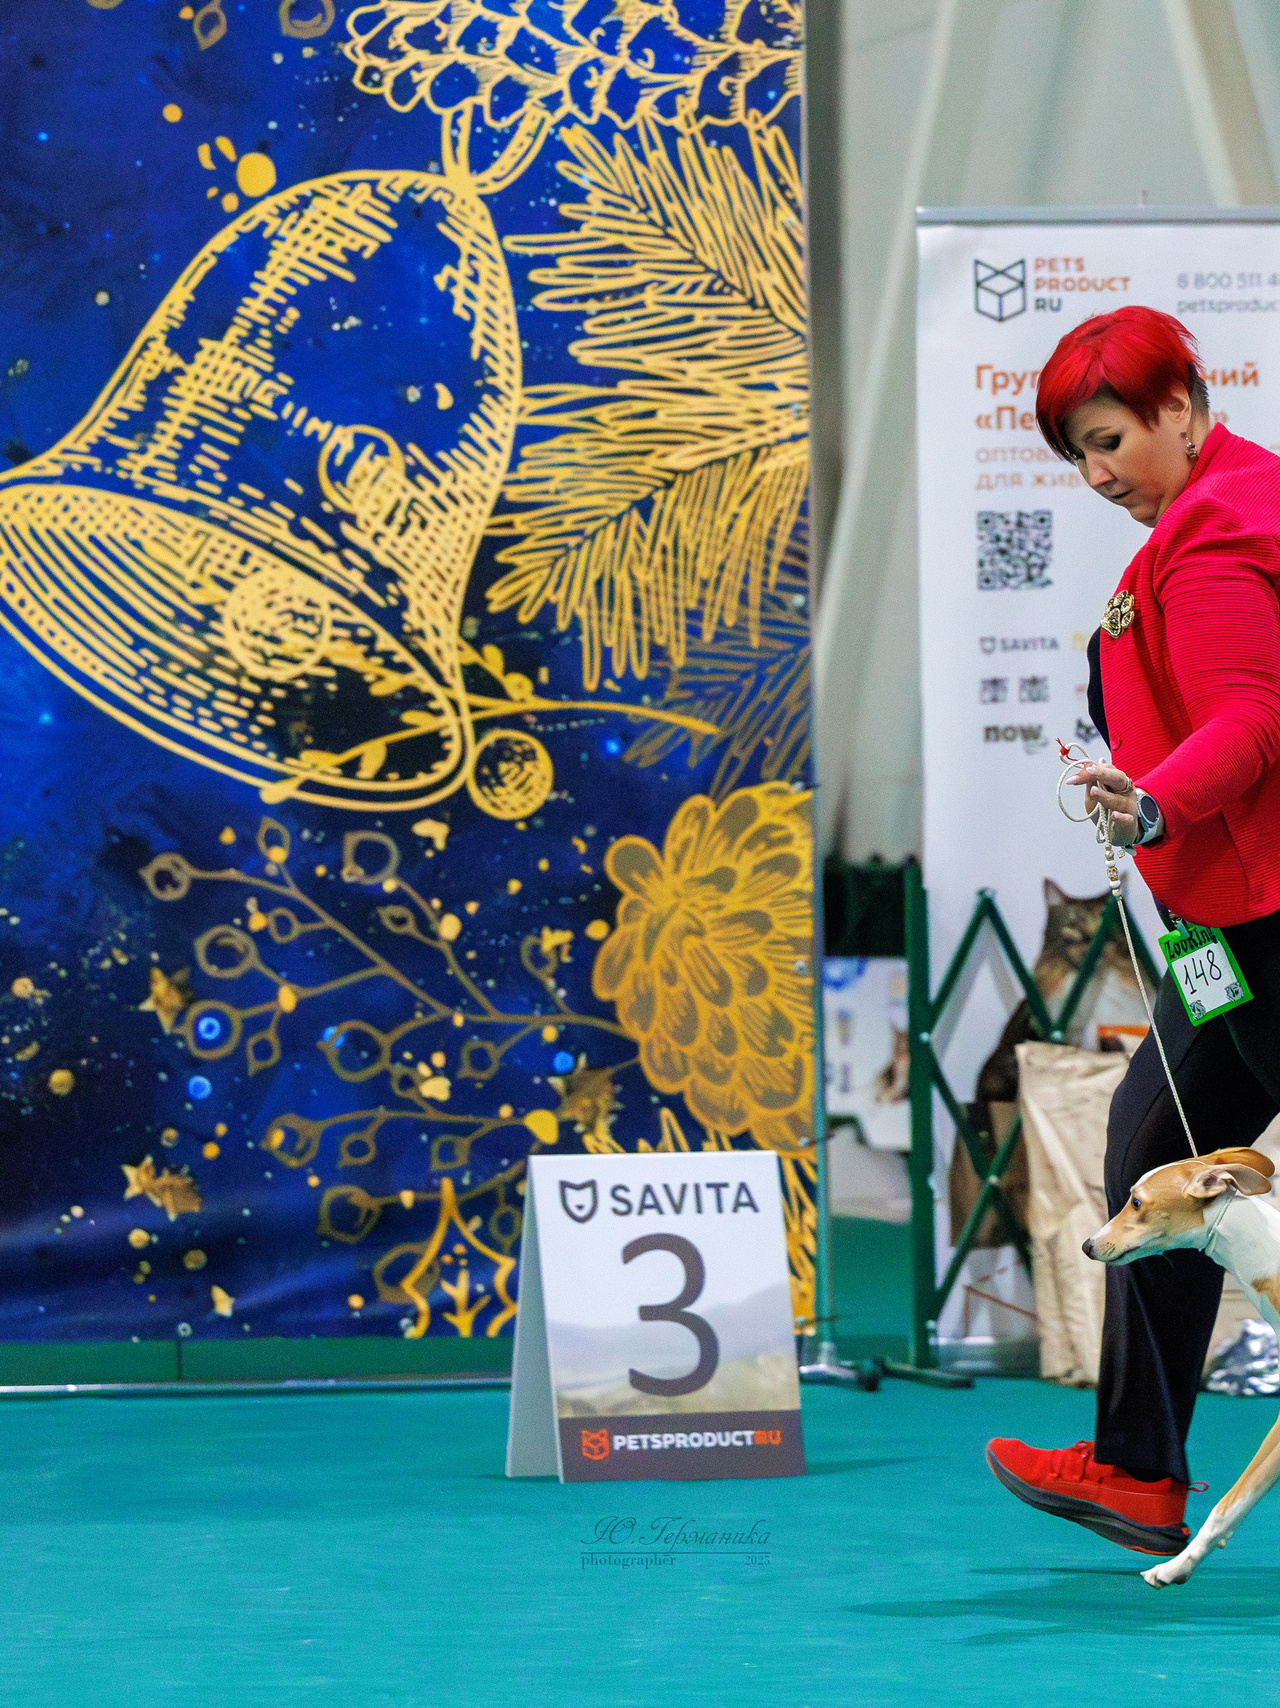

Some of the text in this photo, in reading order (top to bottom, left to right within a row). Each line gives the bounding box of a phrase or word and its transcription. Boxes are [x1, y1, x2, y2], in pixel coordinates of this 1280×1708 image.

[1034, 256, 1086, 273] PETS
[1034, 276, 1131, 293] PRODUCT
[1177, 272, 1190, 290] 8
[1193, 272, 1232, 290] 800
[1034, 297, 1062, 313] RU
[984, 724, 1042, 743] now
[1183, 949, 1222, 995] 148
[610, 1181, 760, 1217] SAVITA
[621, 1232, 720, 1397] 3
